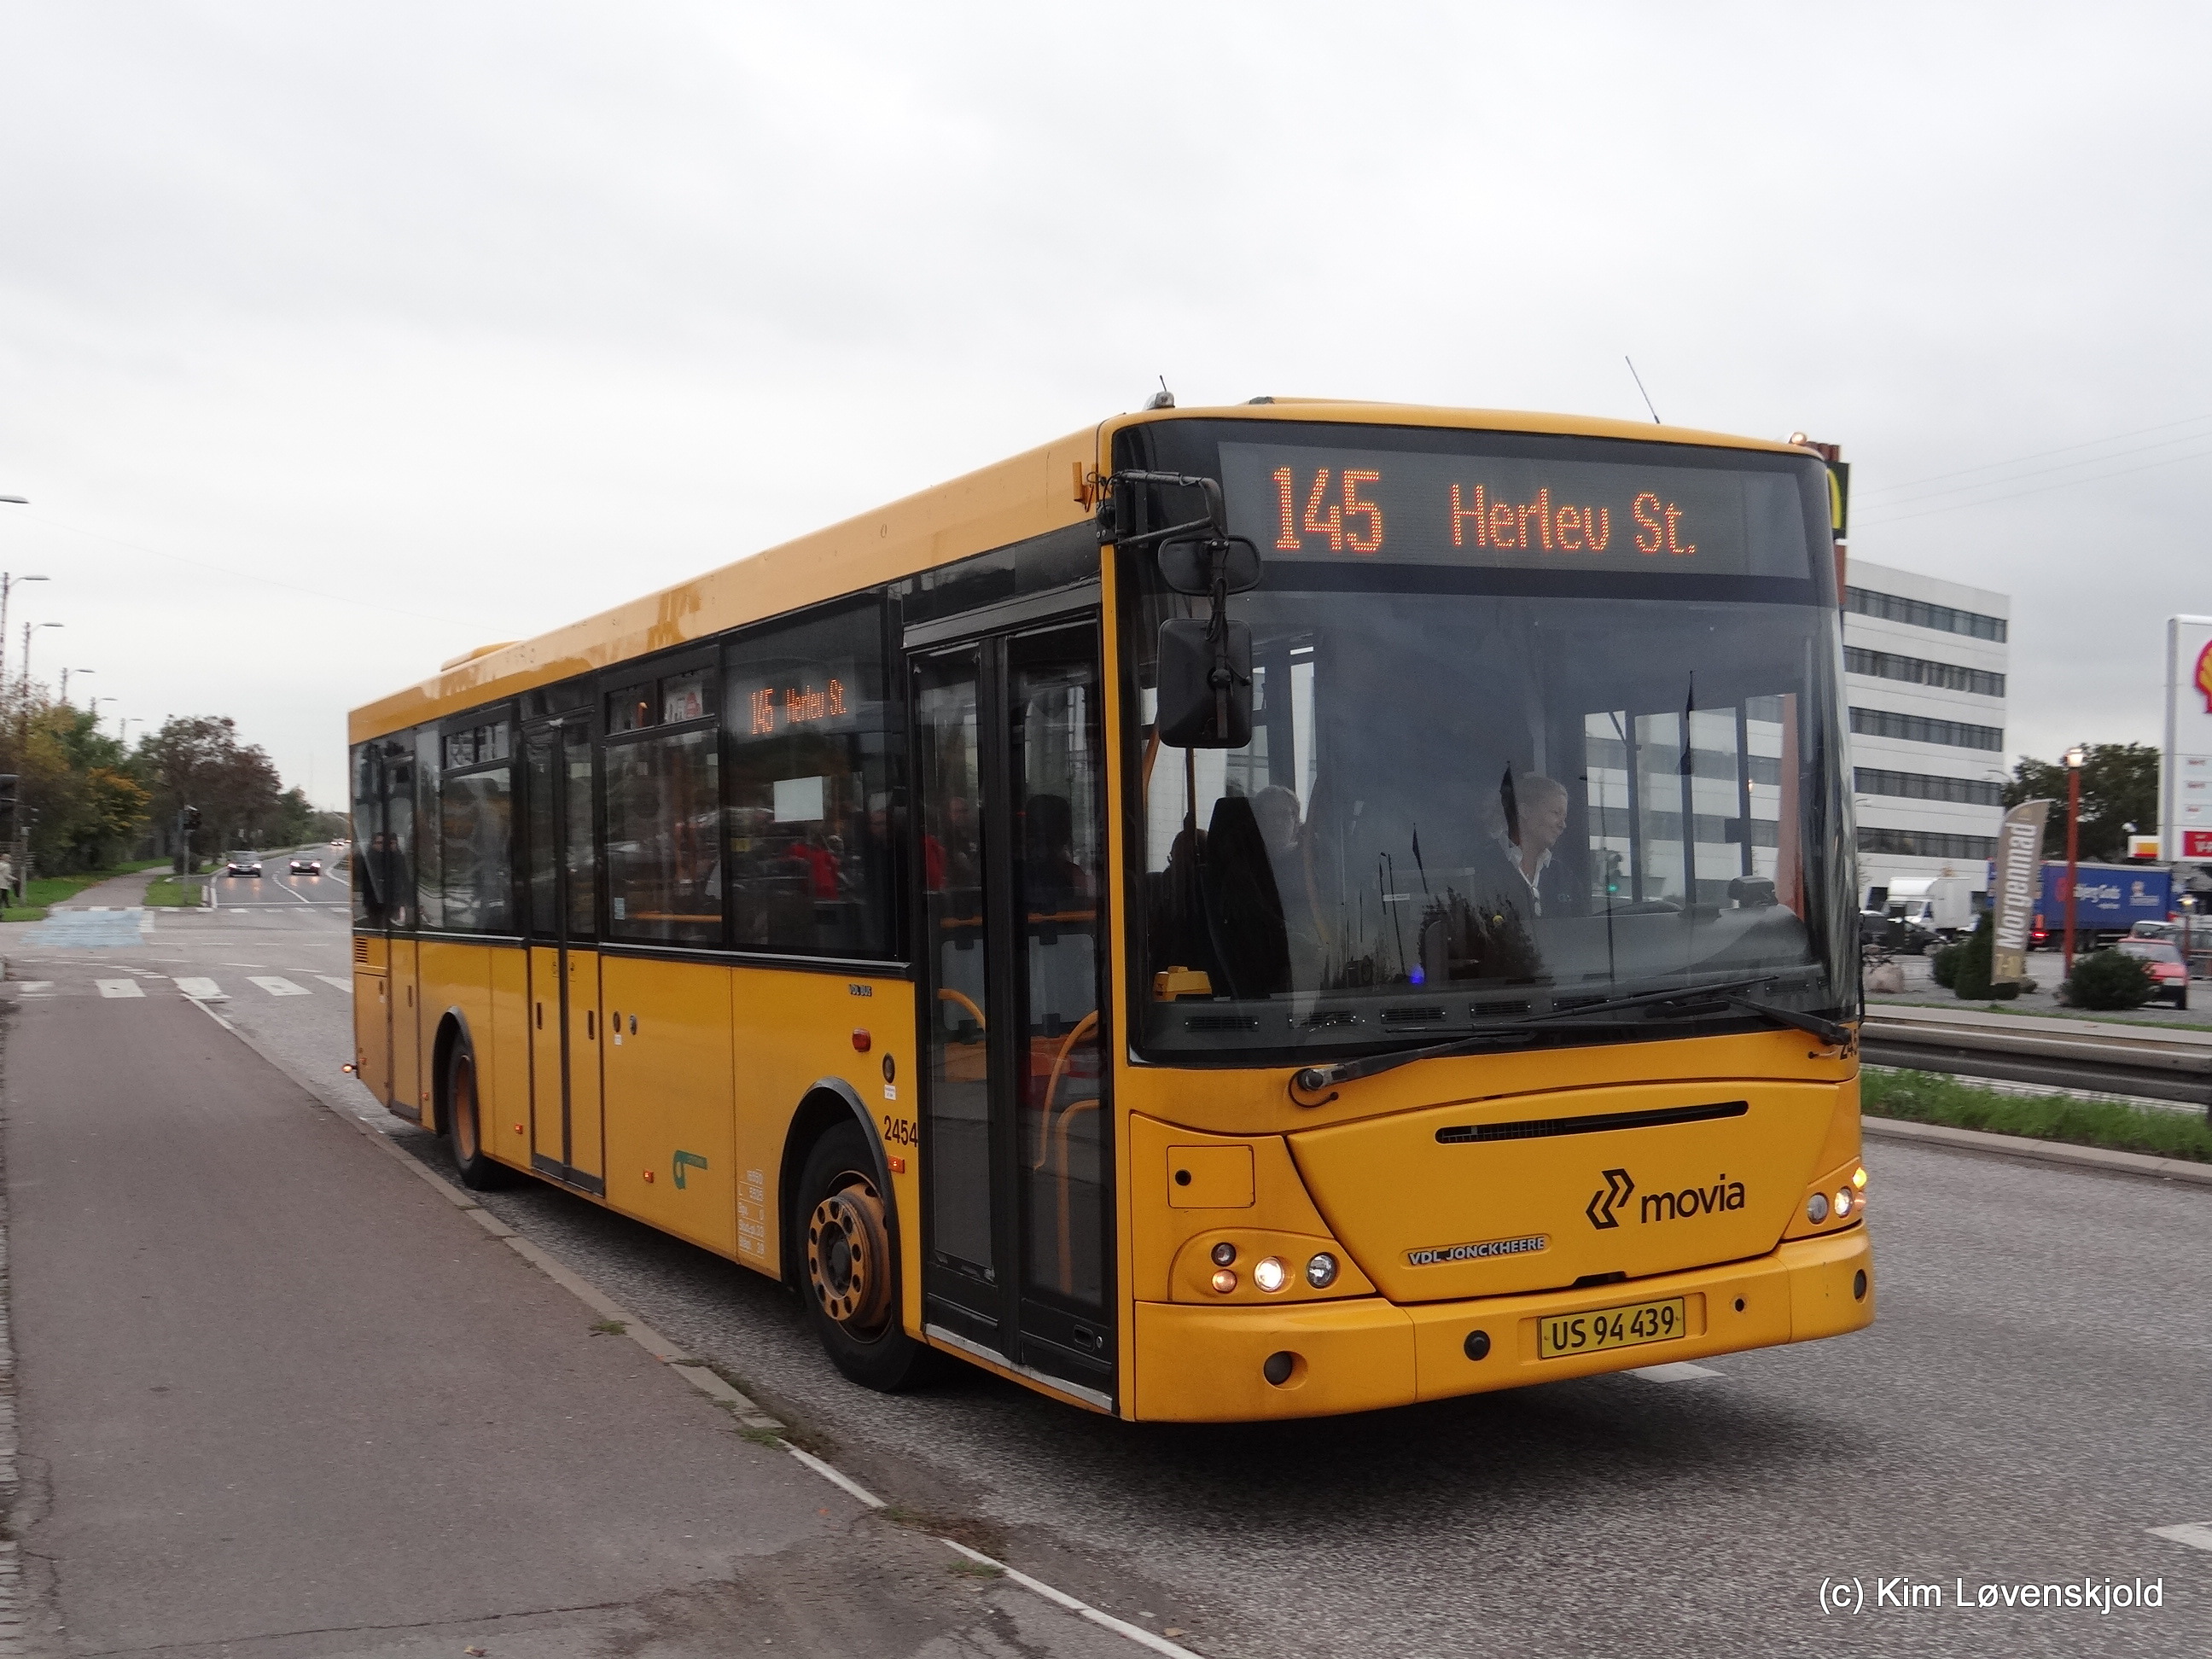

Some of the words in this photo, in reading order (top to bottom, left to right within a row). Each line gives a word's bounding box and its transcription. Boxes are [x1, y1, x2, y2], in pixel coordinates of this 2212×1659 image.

[1272, 466, 1382, 553] 145
[1450, 483, 1610, 551] Herlev
[1632, 492, 1697, 555] St.
[751, 688, 774, 735] 145
[1996, 822, 2038, 950] Morgenmad
[883, 1115, 918, 1148] 2454
[1640, 1173, 1746, 1224] movia
[1408, 1249, 1442, 1266] VDL
[1445, 1236, 1545, 1260] JONCKHEERE
[1551, 1318, 1586, 1351] US
[1593, 1312, 1624, 1346] 94
[1629, 1306, 1675, 1339] 439
